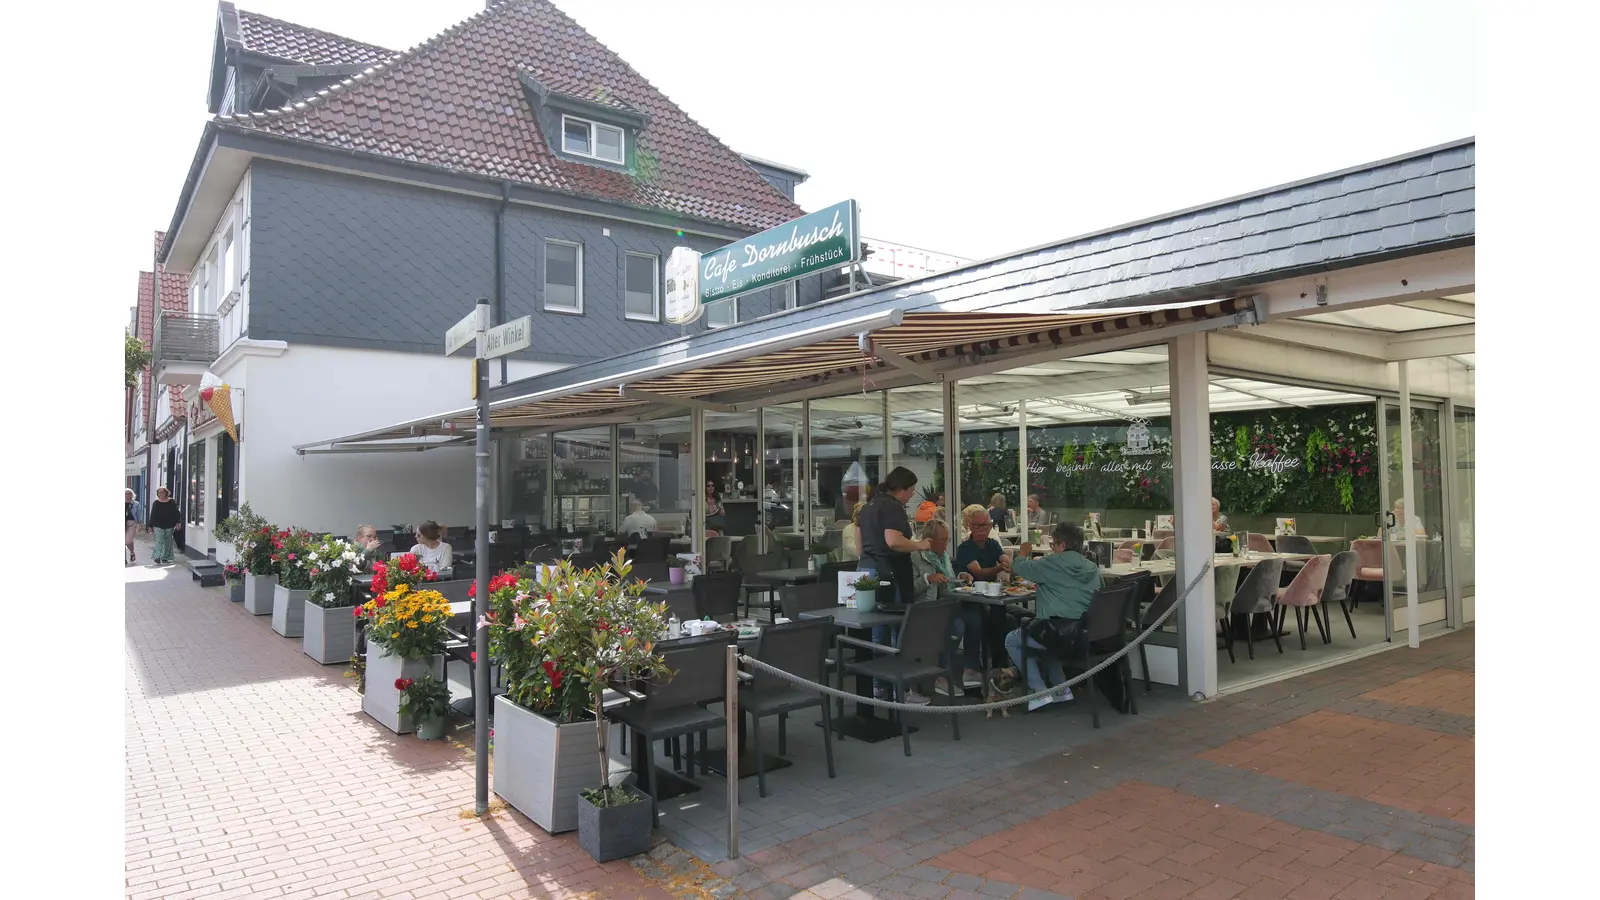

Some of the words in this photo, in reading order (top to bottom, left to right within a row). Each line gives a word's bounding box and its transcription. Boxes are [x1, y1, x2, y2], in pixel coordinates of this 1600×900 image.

[704, 250, 737, 283] Cafe
[742, 210, 845, 268] Dornbusch
[705, 285, 724, 298] Bistro
[732, 280, 744, 290] Eis
[751, 265, 791, 283] Konditorei
[800, 247, 844, 269] Frühstück
[486, 333, 501, 352] Alter
[503, 322, 525, 346] Winkel
[1027, 460, 1046, 474] Hier
[1131, 460, 1153, 471] mit
[1210, 455, 1237, 471] asse
[1249, 451, 1300, 473] Kaffee
